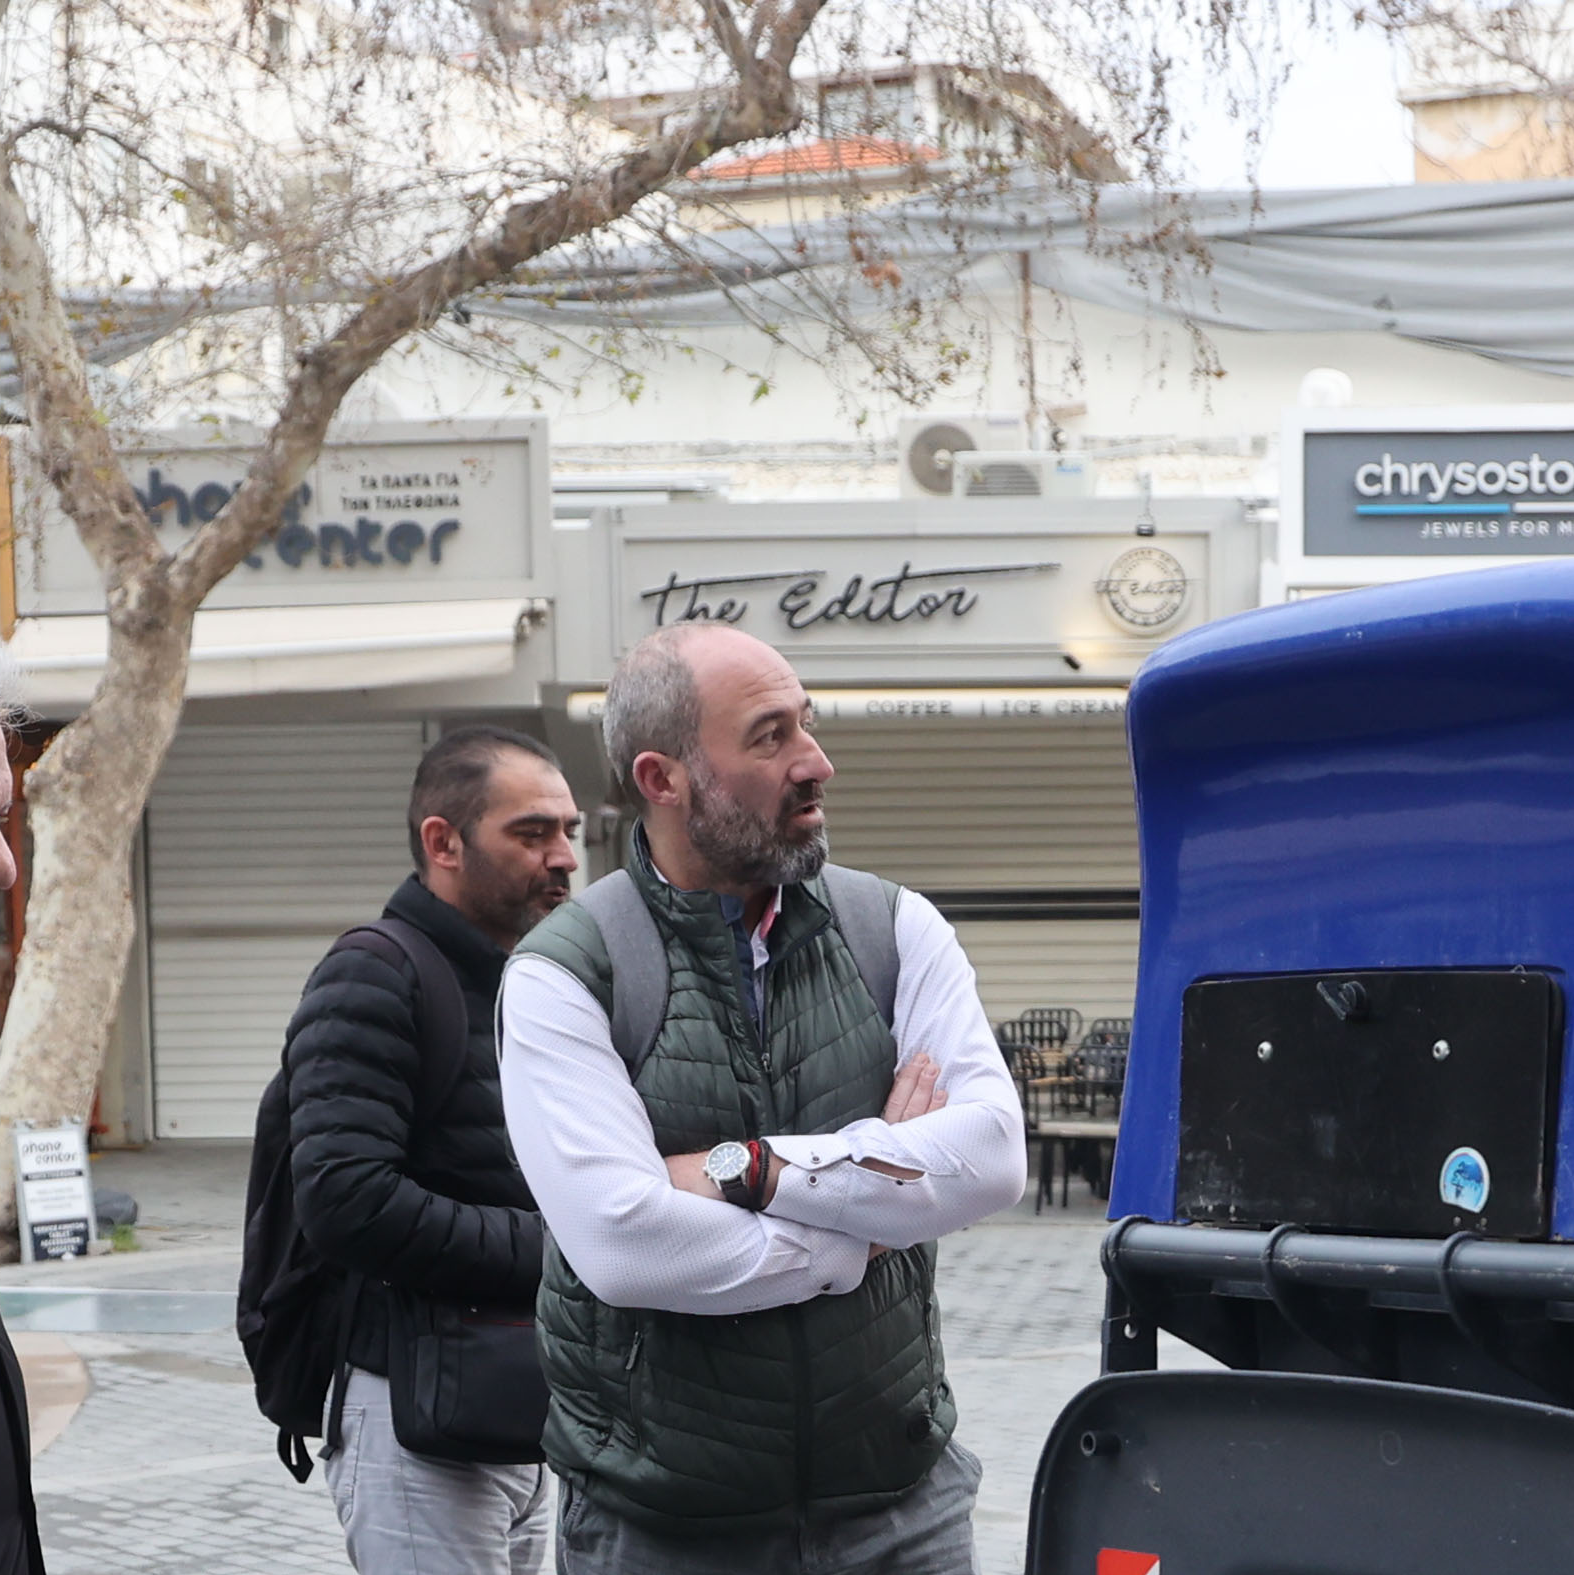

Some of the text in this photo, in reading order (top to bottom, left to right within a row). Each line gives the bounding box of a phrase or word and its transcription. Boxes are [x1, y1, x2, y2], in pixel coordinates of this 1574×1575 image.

[1421, 519, 1499, 538] JEWELS
[1509, 519, 1550, 537] FOR
[779, 561, 1062, 630] Editor
[865, 699, 953, 715] COFFEE
[1001, 699, 1042, 715] ICE
